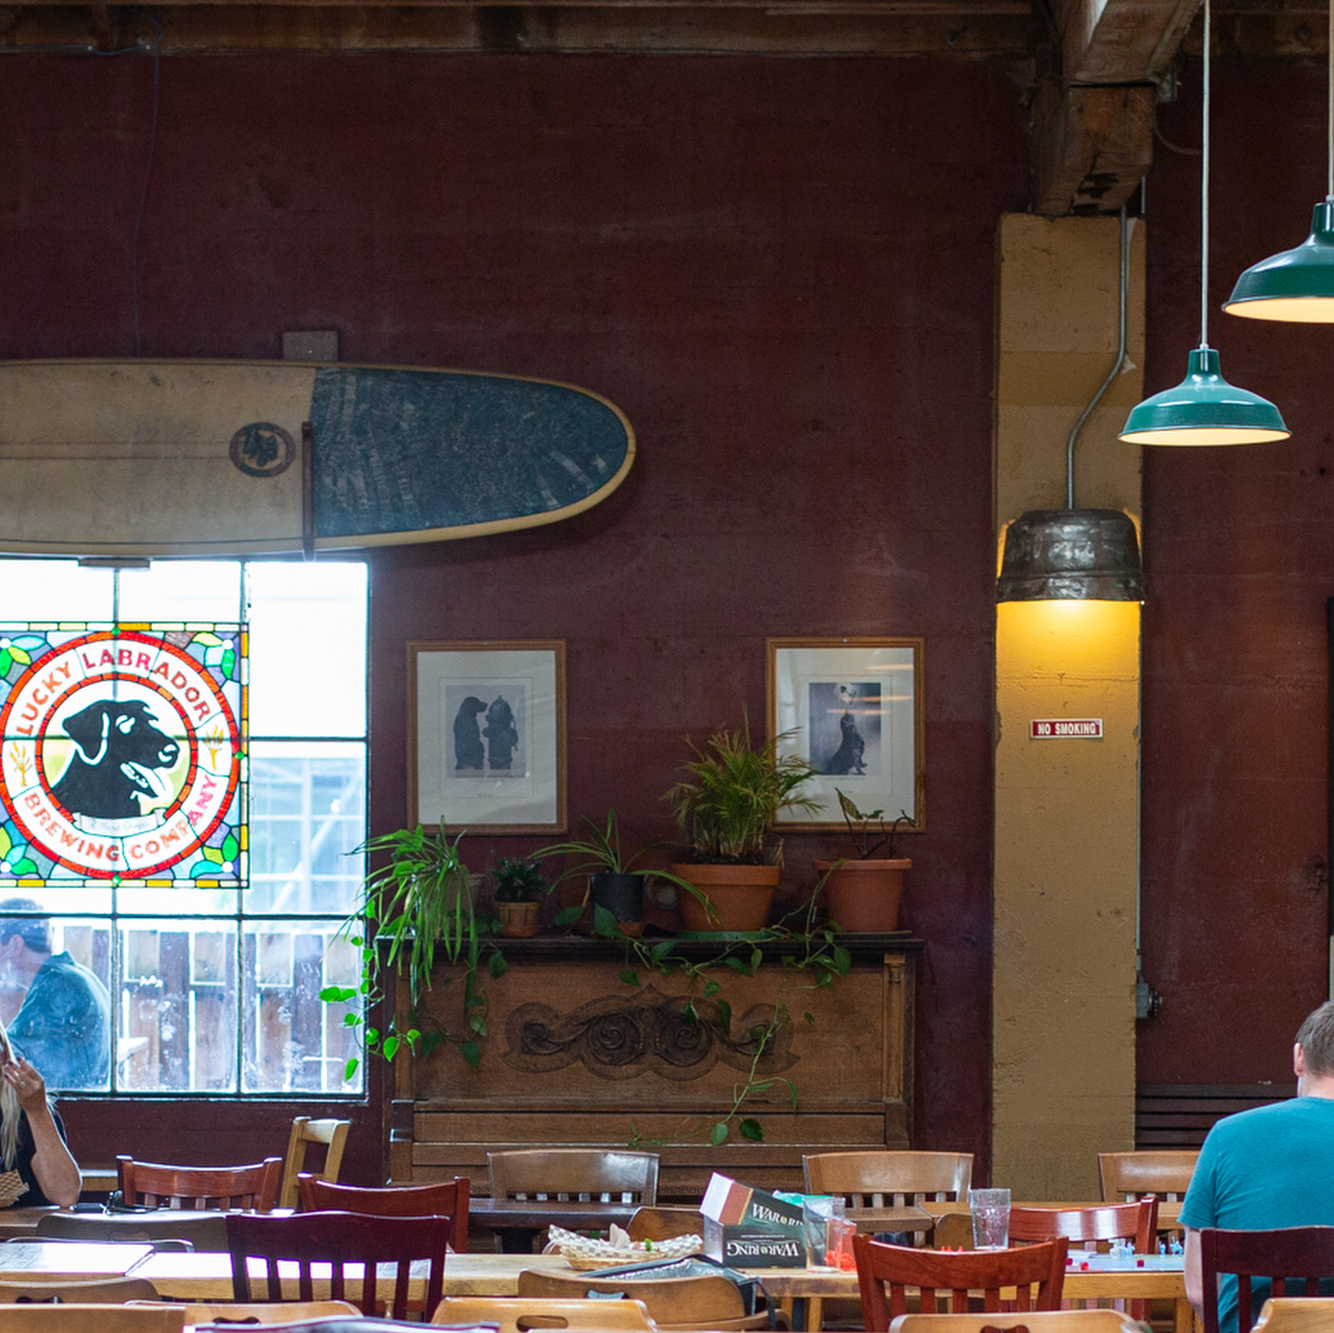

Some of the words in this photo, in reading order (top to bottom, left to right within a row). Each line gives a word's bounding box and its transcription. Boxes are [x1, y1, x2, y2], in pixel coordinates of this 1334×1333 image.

[16, 660, 72, 737] LUCKY
[82, 648, 212, 722] LABRADOR
[1038, 723, 1051, 735] NO
[1055, 723, 1097, 735] SMOKING
[23, 792, 121, 862] BREWING
[128, 774, 218, 860] COMPANY
[752, 1203, 781, 1224] WAR
[727, 1242, 760, 1257] RING
[768, 1242, 799, 1257] WAR
